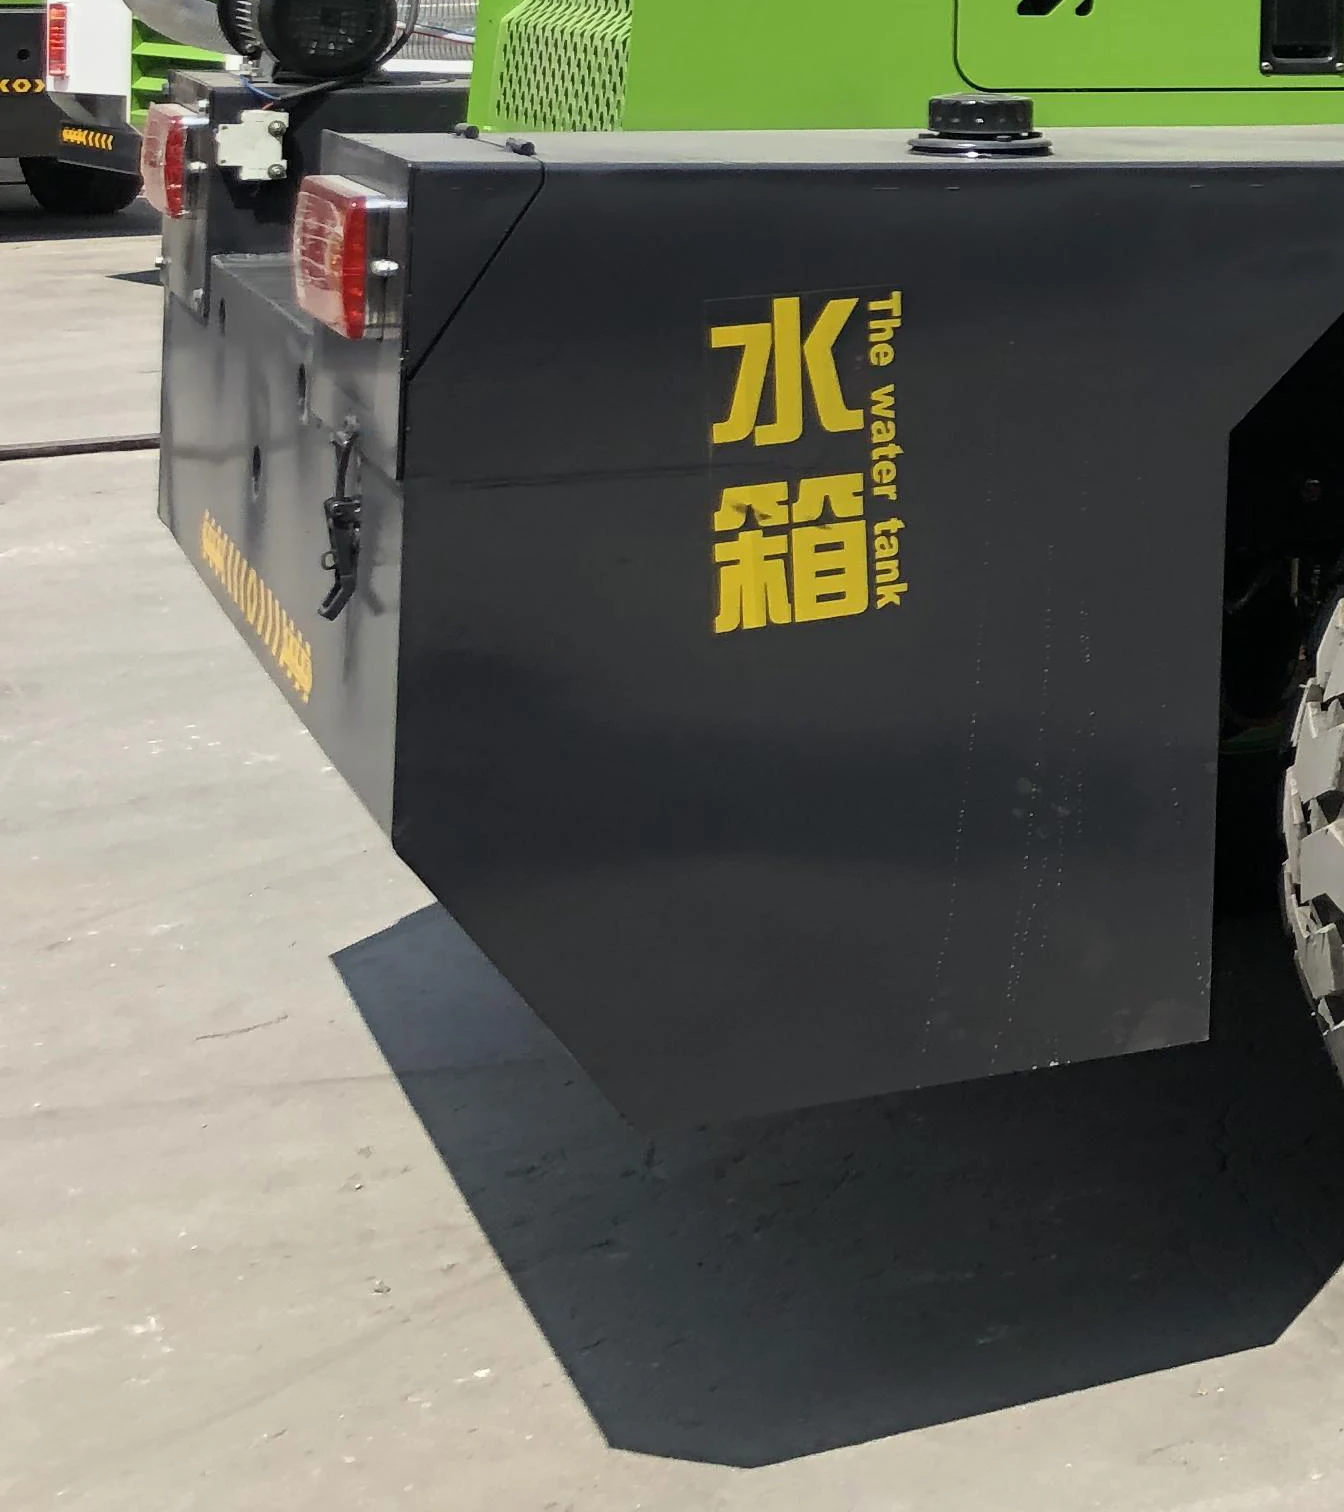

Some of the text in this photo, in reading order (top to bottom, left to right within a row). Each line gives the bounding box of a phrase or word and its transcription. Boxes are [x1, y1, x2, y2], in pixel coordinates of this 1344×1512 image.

[710, 296, 869, 634] 水箱
[868, 290, 909, 609] The water tank
